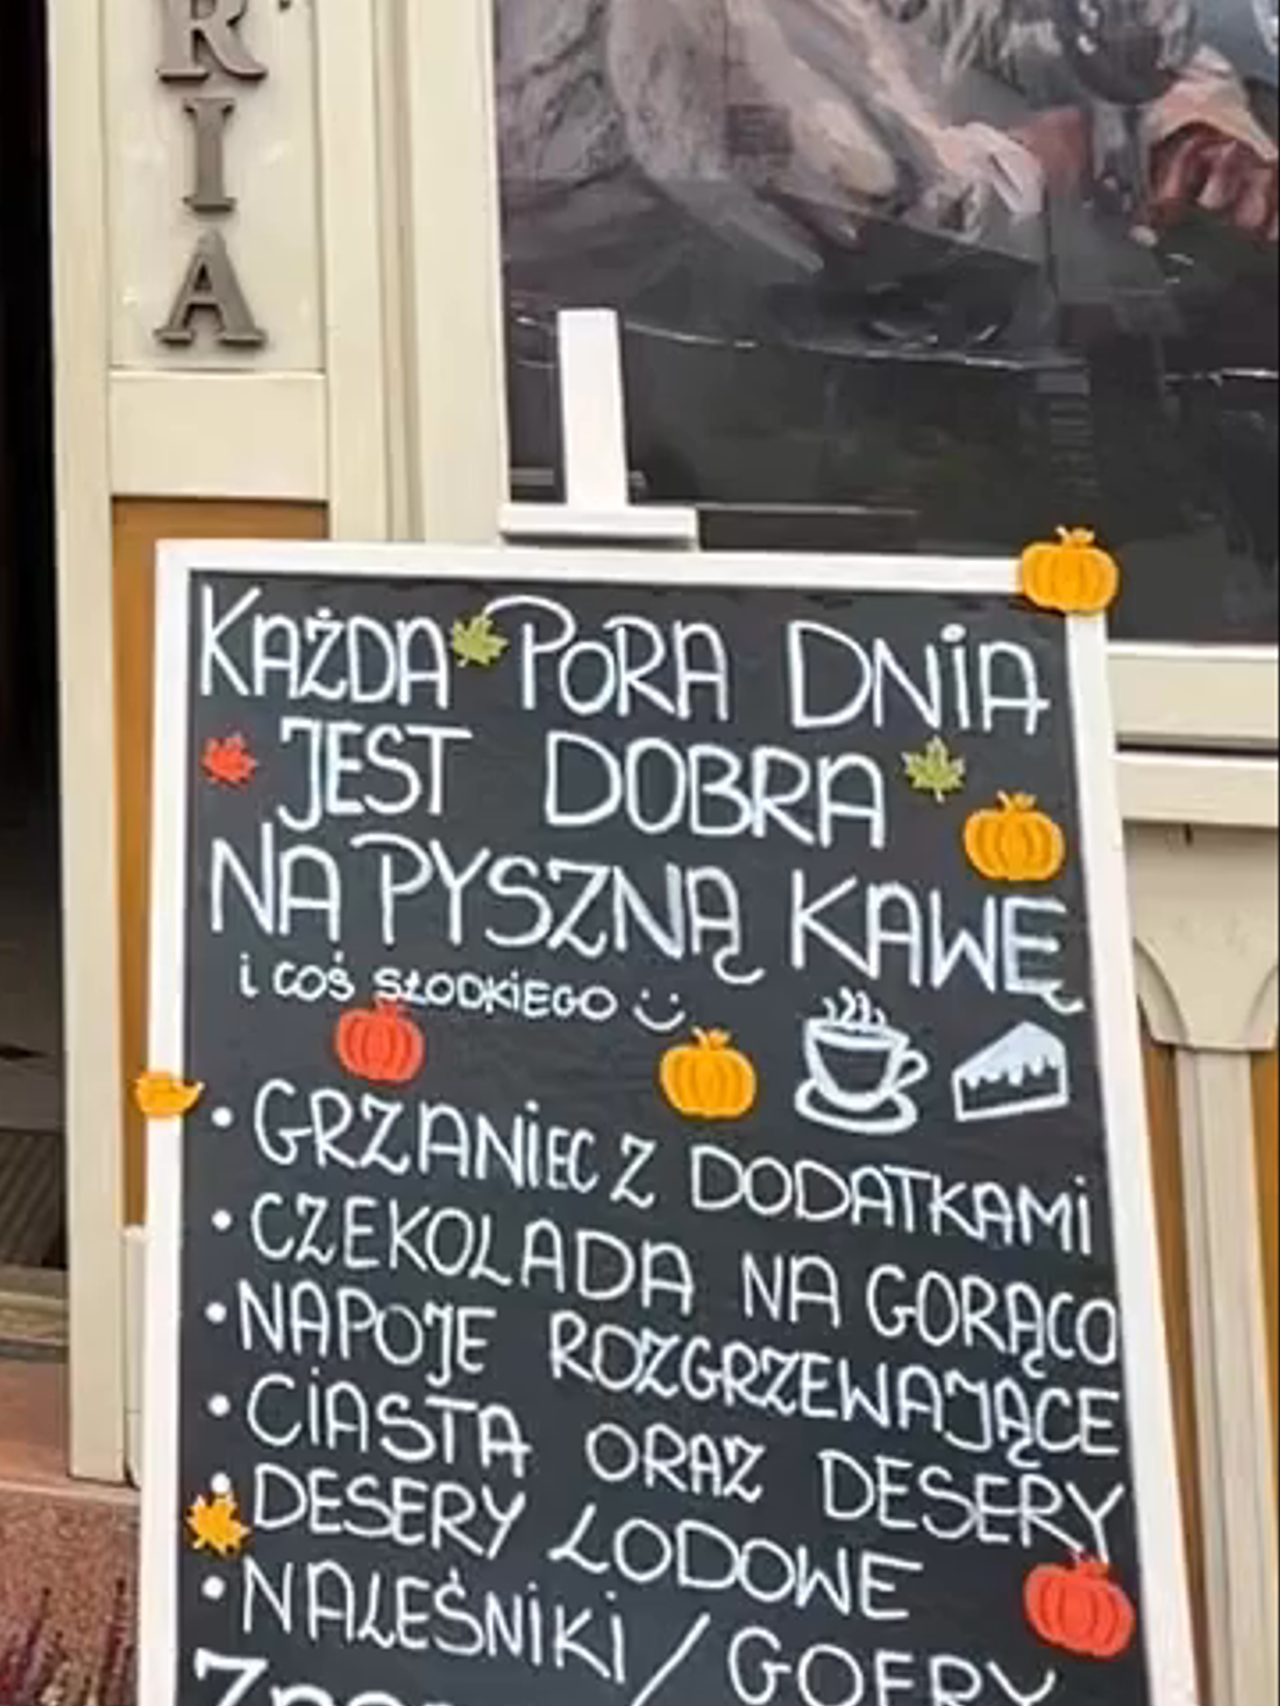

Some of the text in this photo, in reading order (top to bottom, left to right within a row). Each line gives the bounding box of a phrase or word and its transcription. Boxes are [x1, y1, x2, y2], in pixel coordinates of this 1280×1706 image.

[201, 584, 449, 709] KAŻDA
[482, 595, 728, 721] PORA
[276, 717, 885, 848] JEST DOBRA
[211, 822, 1085, 1014] NA PYSZNĄ KAWĘ
[610, 1133, 656, 1208] Z
[251, 1192, 1118, 1378] CZEKOLADA NA GORĄCO
[238, 1279, 1121, 1469] NAPOJE ROZGRZEWAJĄCE
[254, 1463, 924, 1620] DESERY LODOWE
[585, 1422, 766, 1504] ORAZ
[818, 1448, 1125, 1565] DESERY
